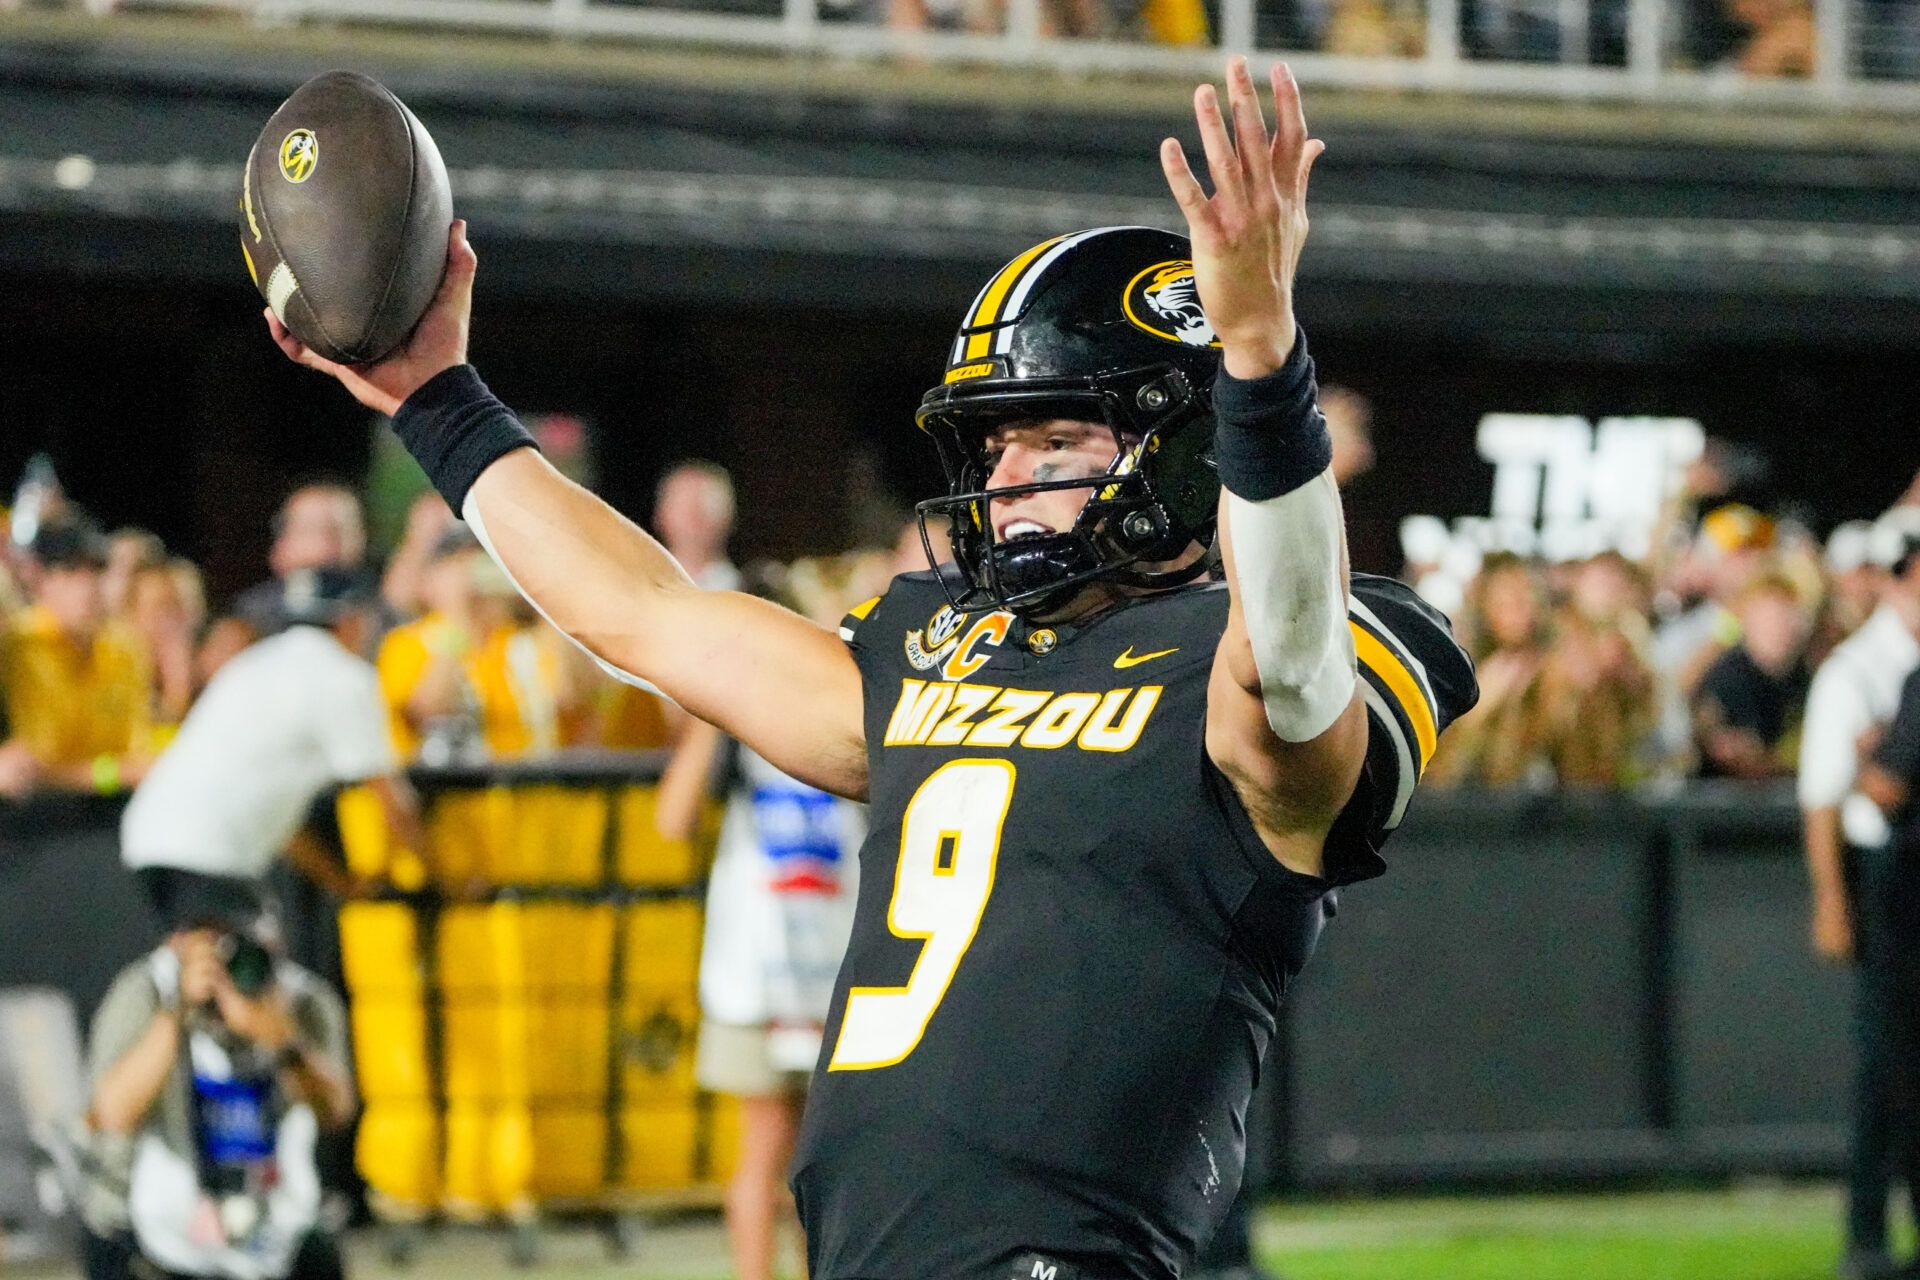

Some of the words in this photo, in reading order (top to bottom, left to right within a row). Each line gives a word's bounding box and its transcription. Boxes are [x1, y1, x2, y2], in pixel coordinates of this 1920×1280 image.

[943, 611, 1017, 682] C
[884, 678, 1163, 752] MIZZOU
[828, 758, 1016, 1072] 9
